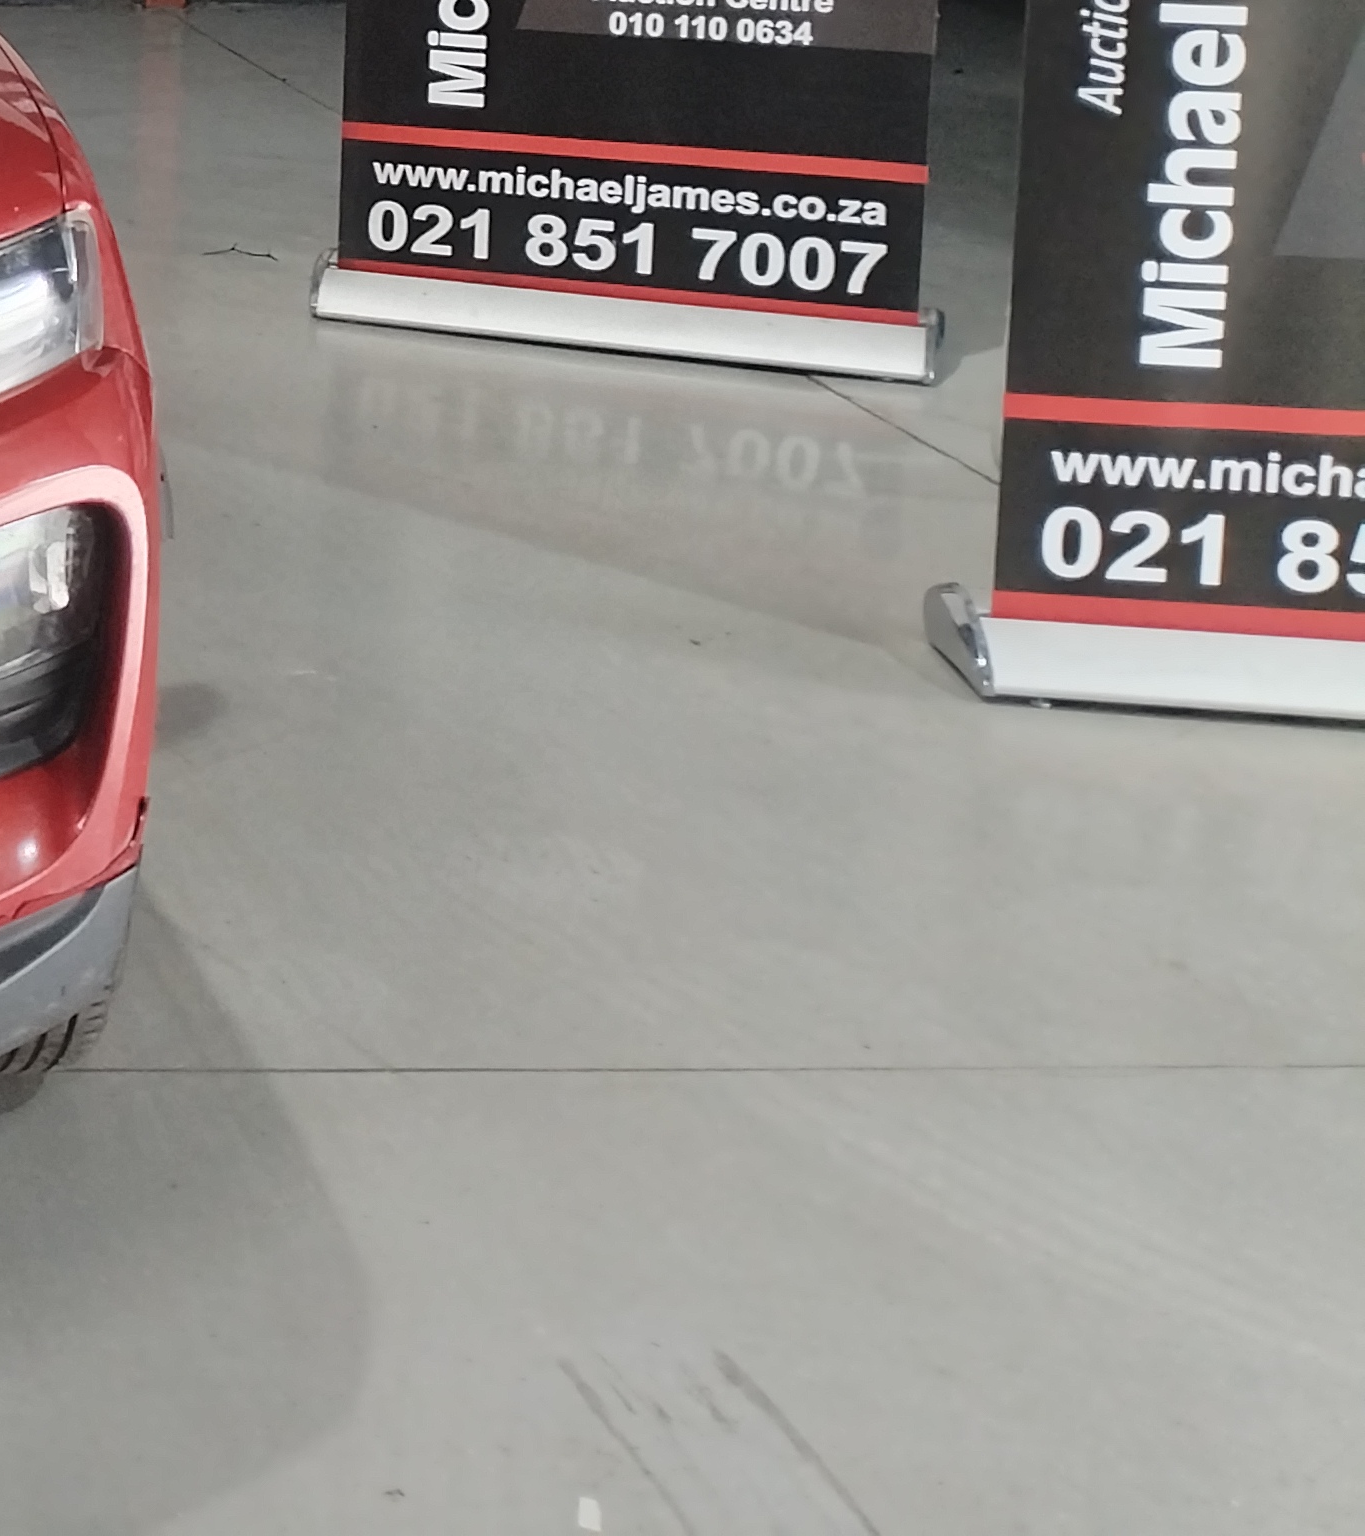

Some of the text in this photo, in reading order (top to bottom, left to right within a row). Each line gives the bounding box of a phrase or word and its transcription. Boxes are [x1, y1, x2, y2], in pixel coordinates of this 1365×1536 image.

[608, 10, 814, 46] 010 110 0634
[373, 161, 888, 227] www.michaeljames.co.za
[1138, 2, 1249, 369] Michael
[367, 200, 888, 295] 021 851 7007
[1041, 505, 1226, 587] 021
